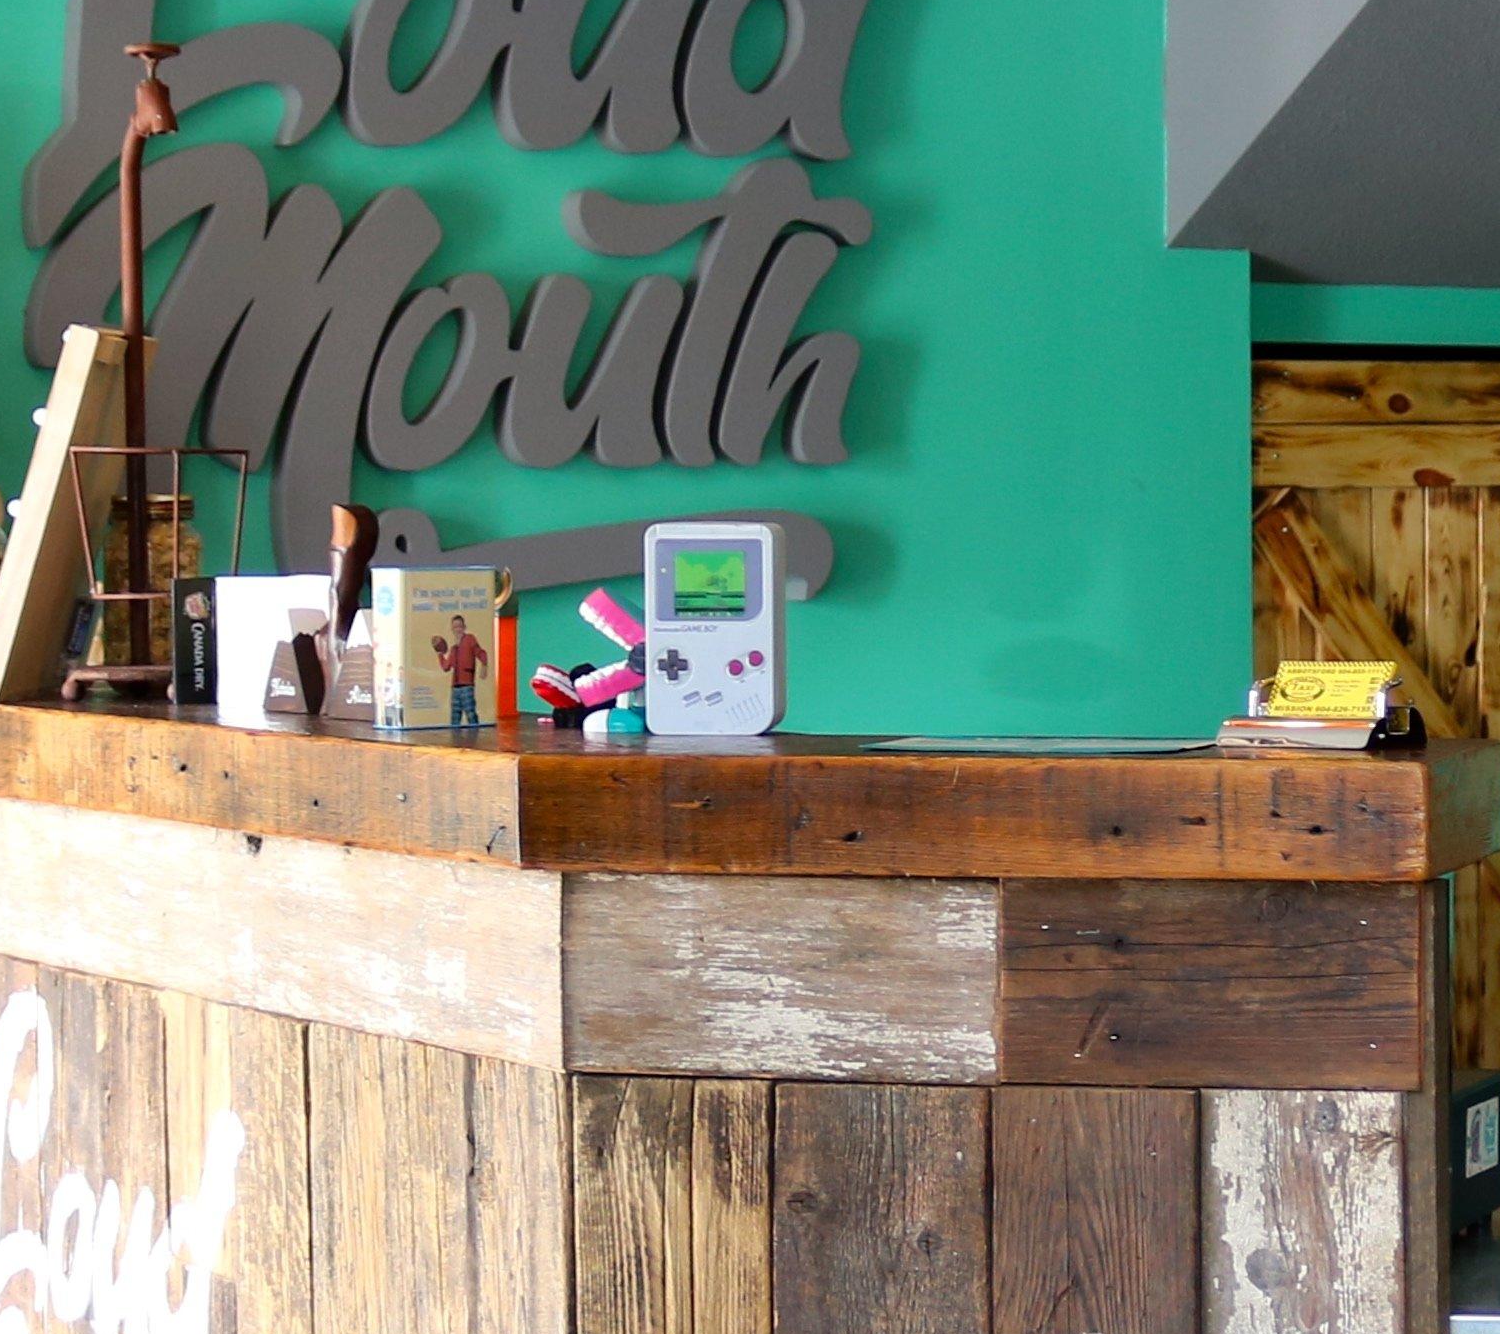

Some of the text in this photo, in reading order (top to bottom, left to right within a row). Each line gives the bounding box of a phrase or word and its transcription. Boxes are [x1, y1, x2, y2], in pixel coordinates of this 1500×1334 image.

[25, 157, 873, 597] Mouth
[191, 622, 205, 691] CANADA DRY
